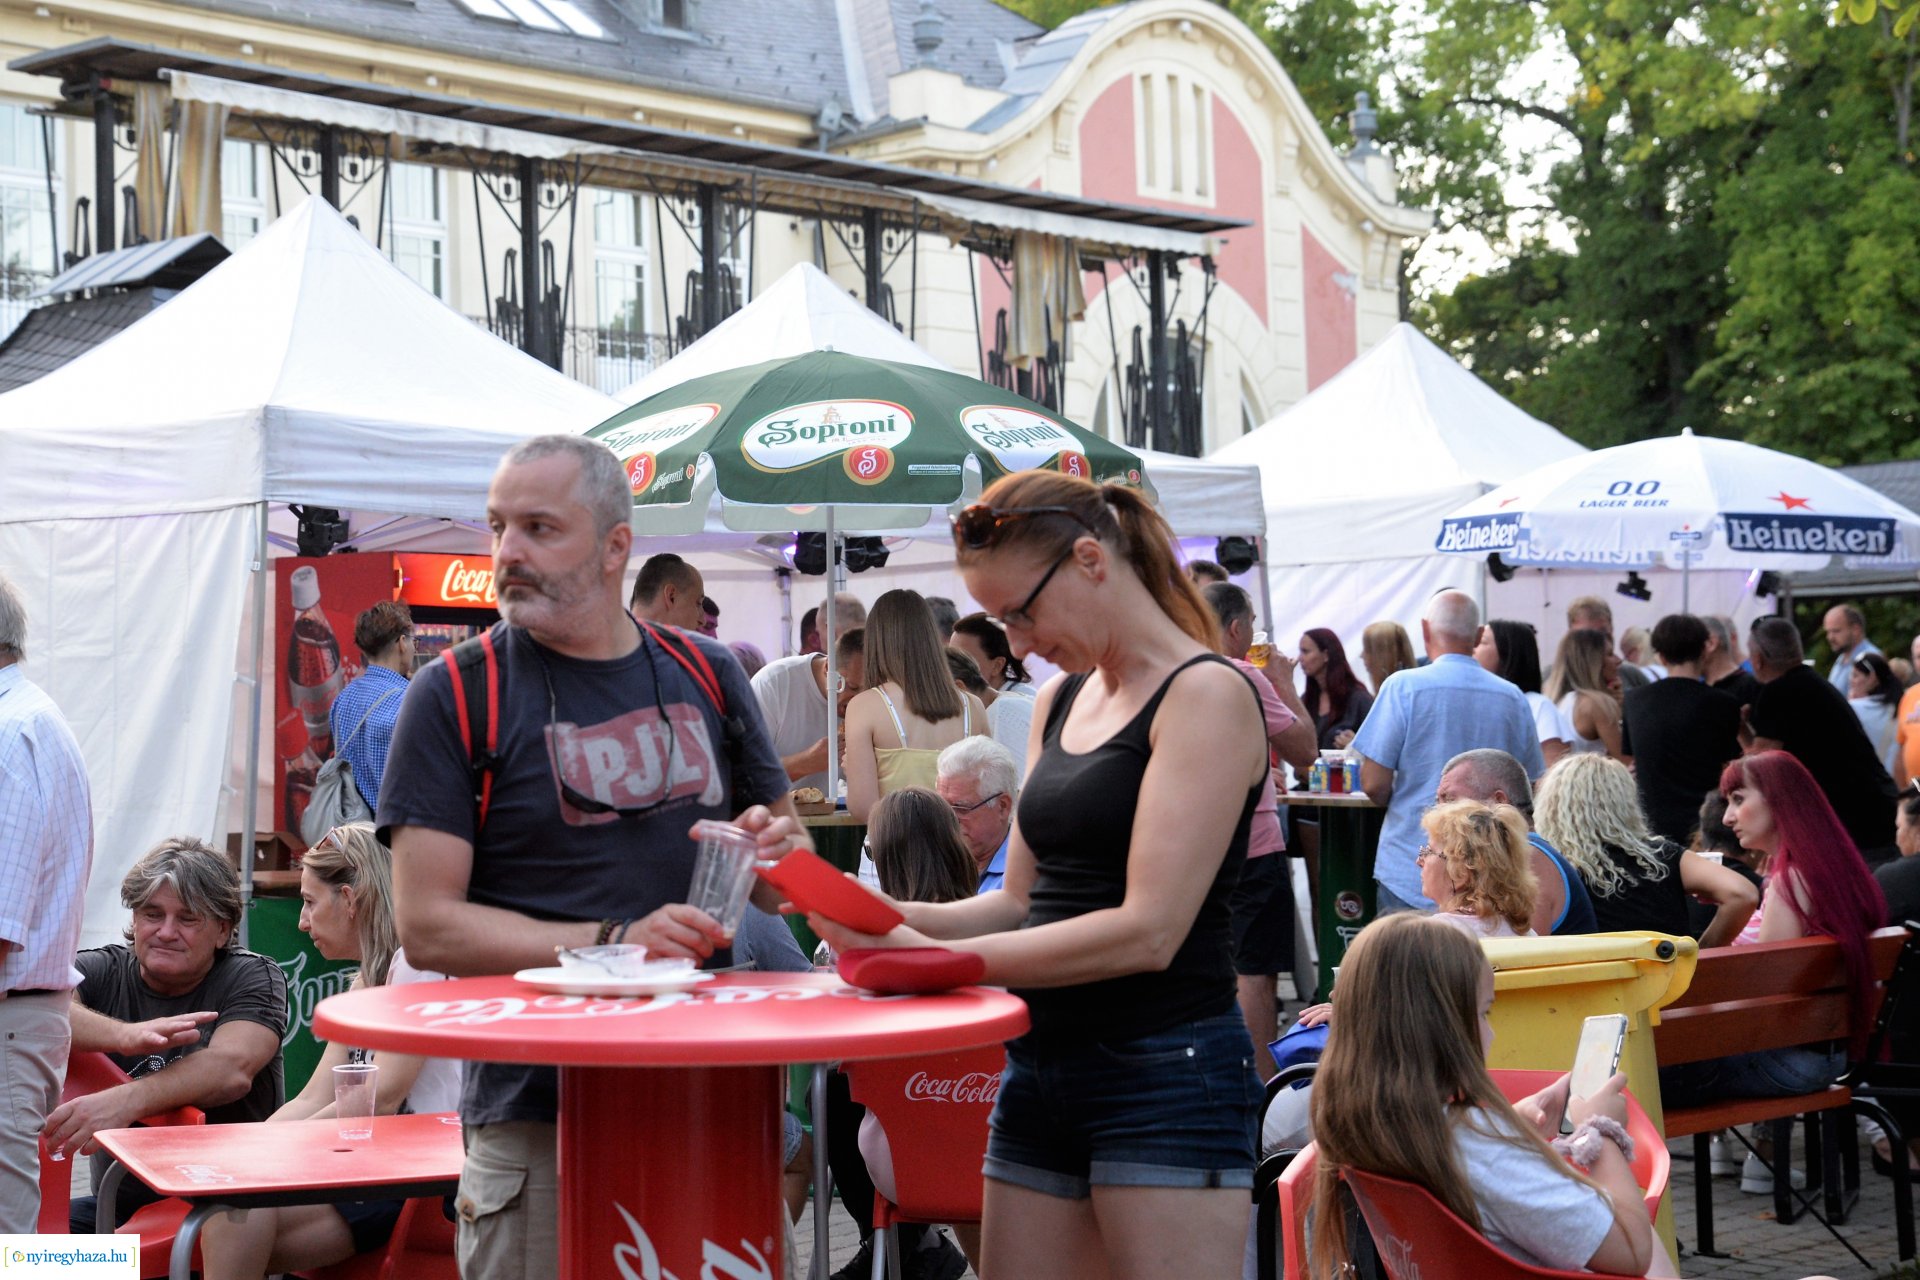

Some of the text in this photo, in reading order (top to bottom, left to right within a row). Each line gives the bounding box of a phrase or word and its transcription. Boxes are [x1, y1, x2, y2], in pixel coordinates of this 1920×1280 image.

[601, 418, 704, 453] Soproni
[757, 414, 897, 449] Soproni
[971, 421, 1065, 453] Soproni
[1579, 499, 1670, 509] LAGER BEER
[1728, 518, 1888, 554] Heineken
